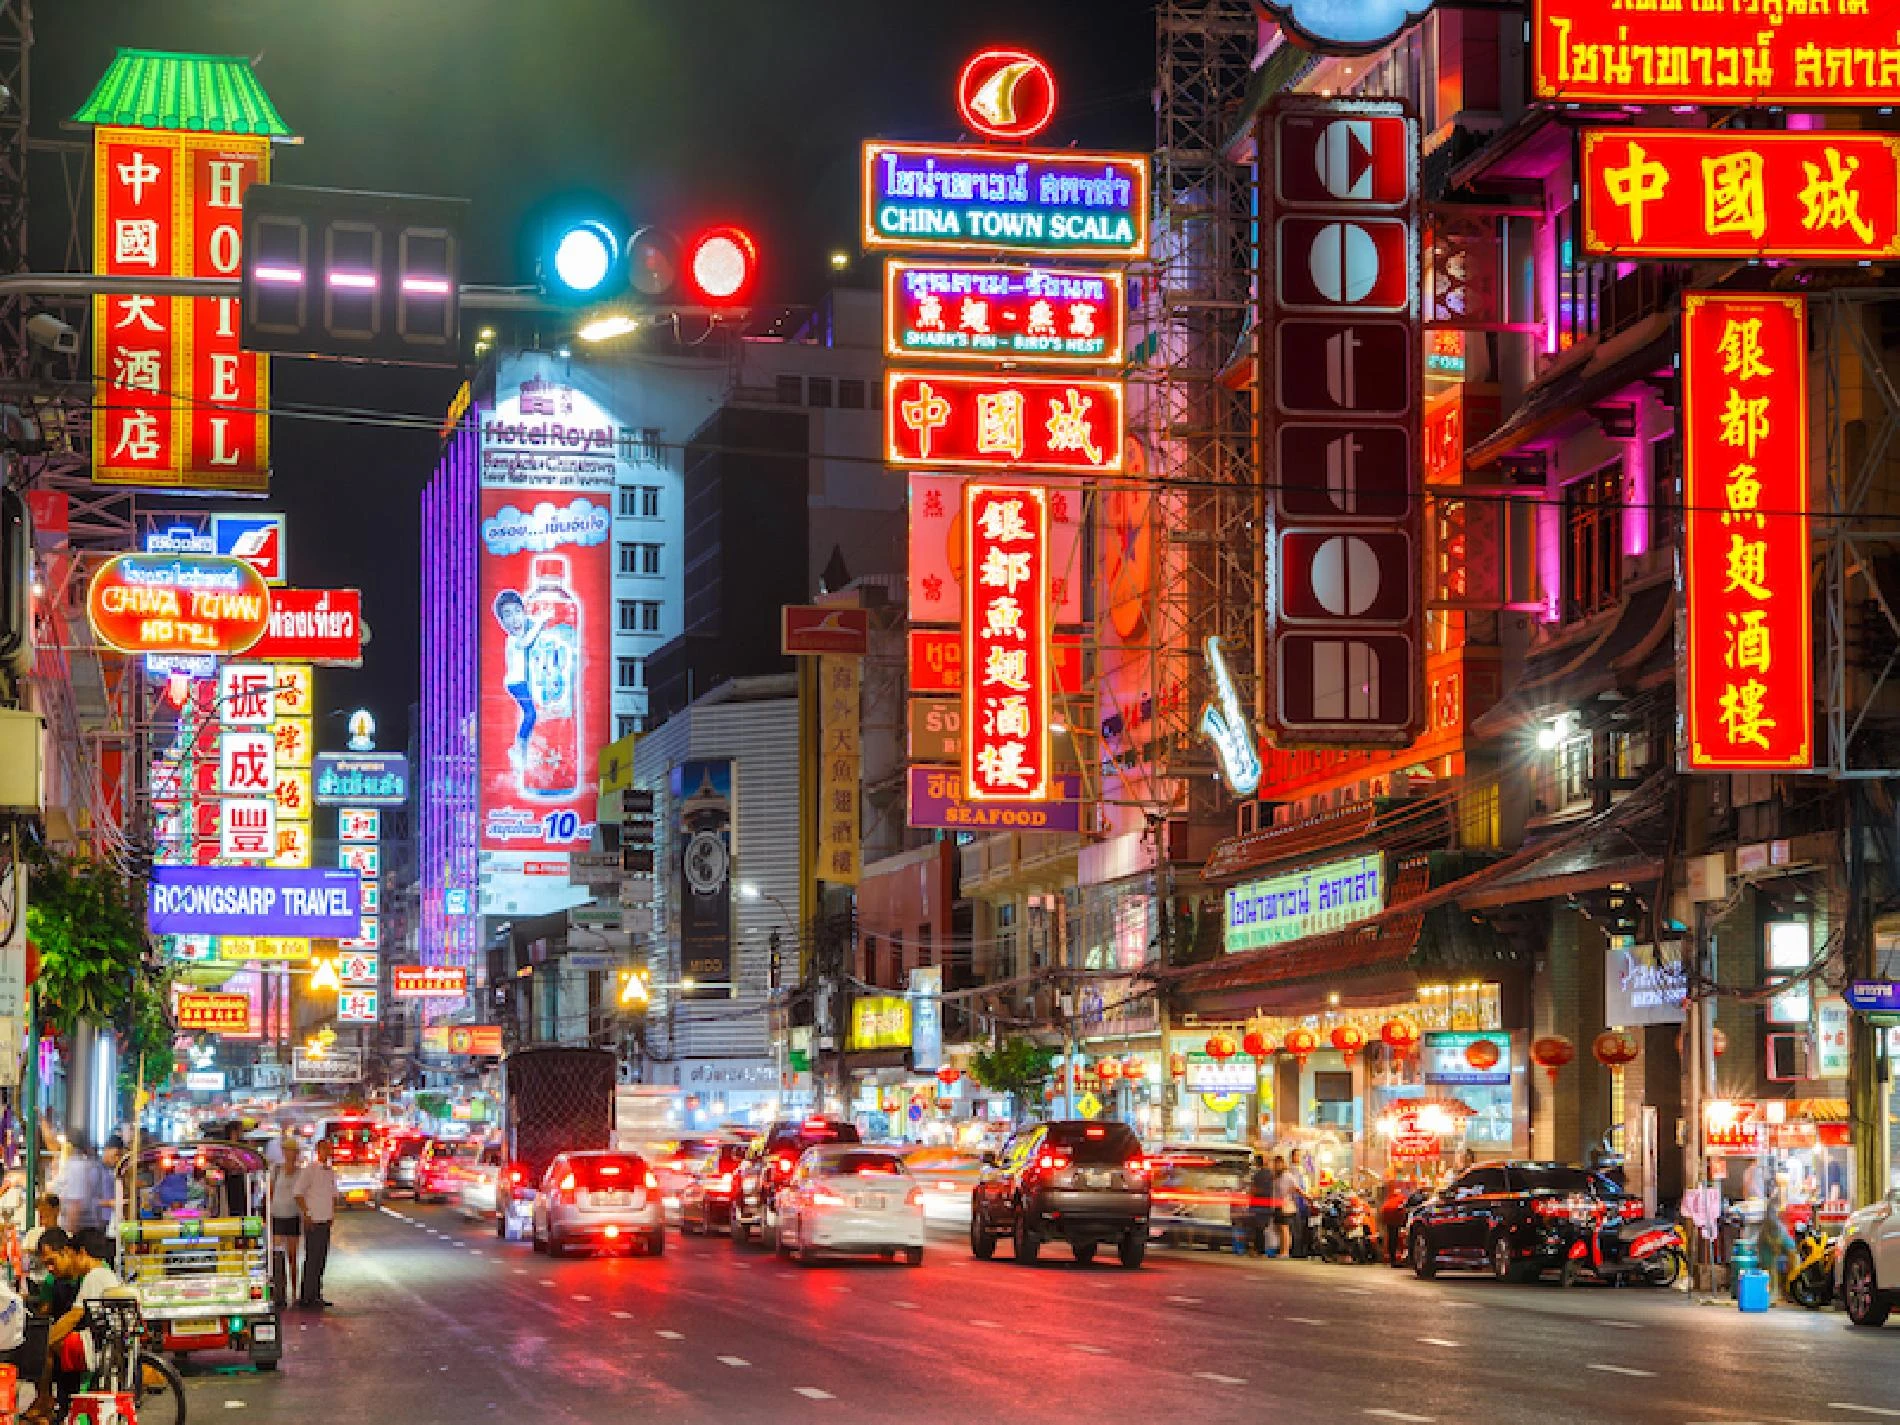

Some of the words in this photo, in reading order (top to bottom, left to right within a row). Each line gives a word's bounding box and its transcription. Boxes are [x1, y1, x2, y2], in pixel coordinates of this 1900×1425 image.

[1550, 16, 1774, 87] ไชน่าทาวน์
[1604, 141, 1874, 244] 中國城
[881, 206, 960, 235] CHINA
[966, 211, 1043, 238] TOWN
[1050, 213, 1133, 242] SCALA
[486, 421, 547, 445] Hotel
[551, 424, 613, 450] Royal
[902, 382, 1102, 464] 中國城
[1718, 319, 1775, 749] 銀都魚翅酒樓
[102, 586, 180, 617] CHINA
[192, 592, 262, 622] TOWN
[140, 619, 219, 647] HOTEL
[544, 812, 577, 839] 10
[945, 808, 1047, 826] SEAFOOD
[154, 884, 276, 916] ROONGSARP
[282, 888, 354, 917] TRAVEL
